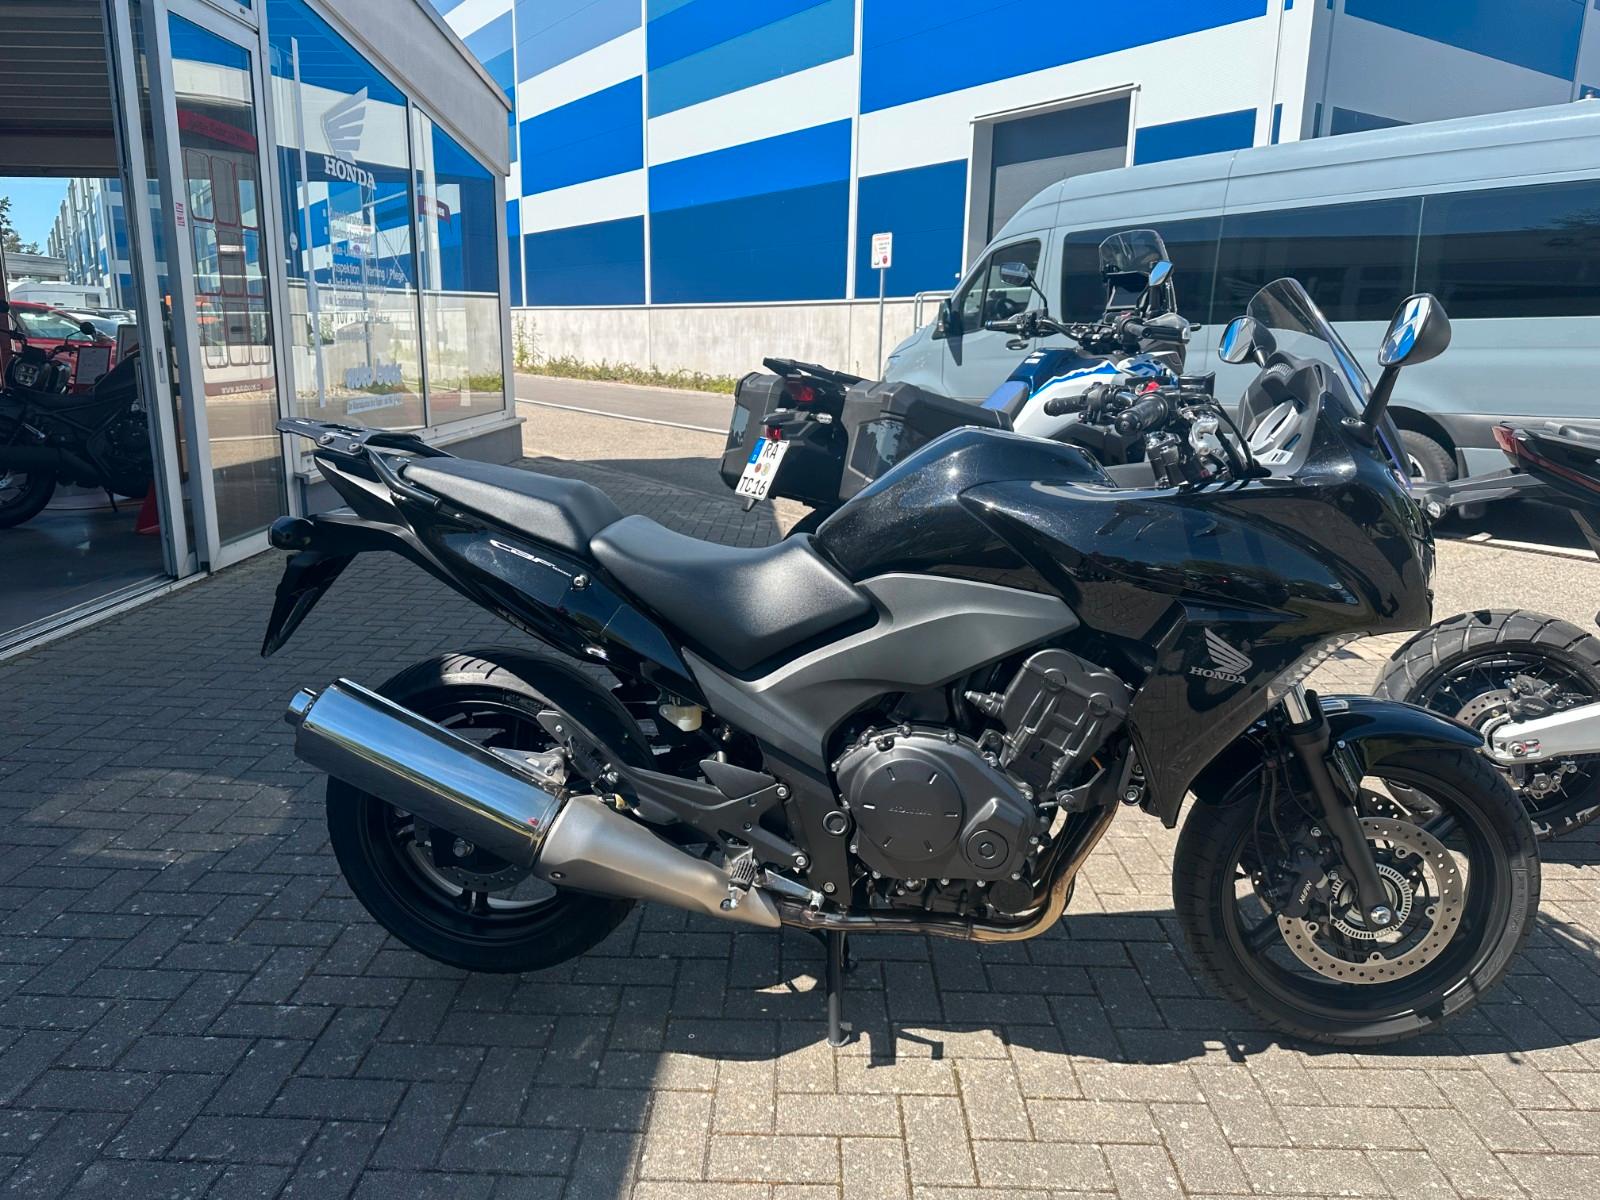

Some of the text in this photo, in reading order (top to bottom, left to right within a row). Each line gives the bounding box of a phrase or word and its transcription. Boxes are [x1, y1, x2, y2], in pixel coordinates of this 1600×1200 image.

[323, 154, 377, 191] HONDA
[763, 442, 779, 459] RA
[1189, 665, 1248, 685] HONDA
